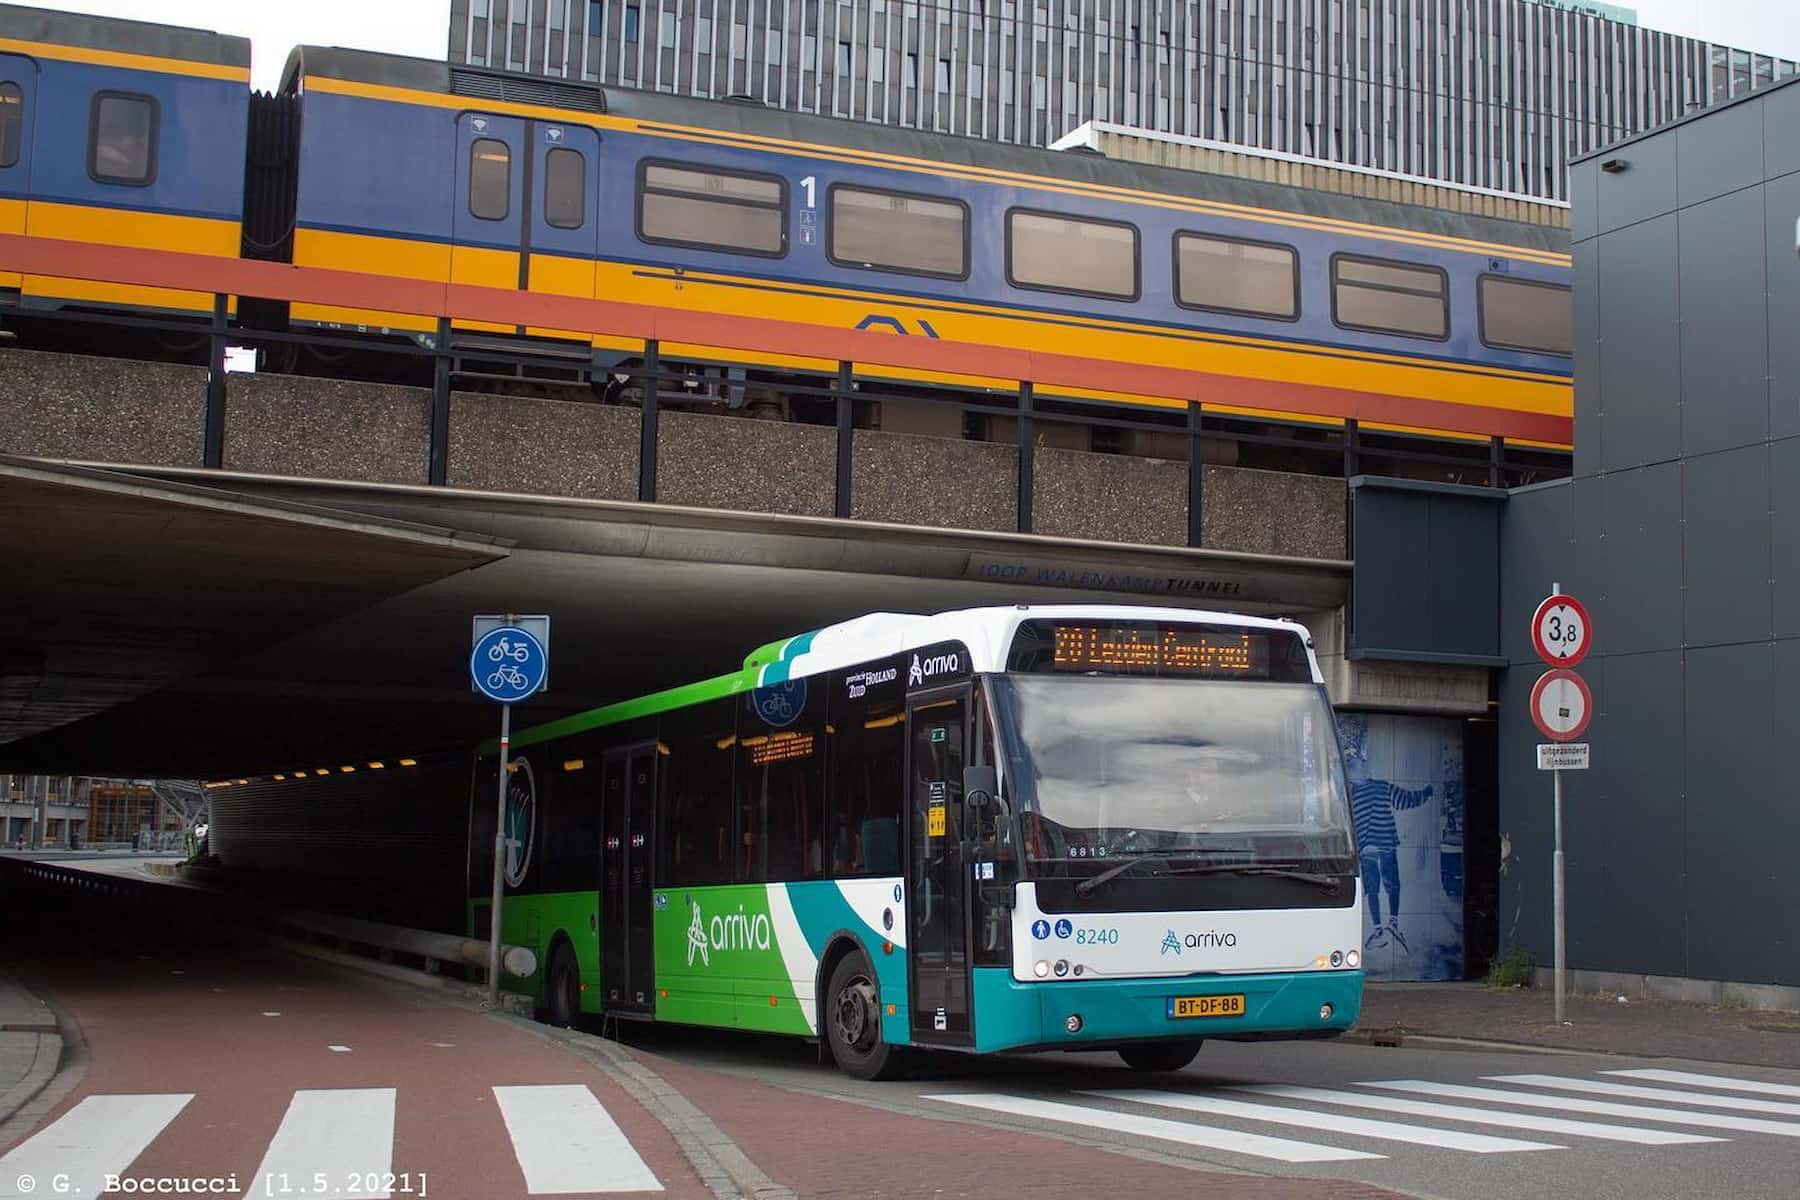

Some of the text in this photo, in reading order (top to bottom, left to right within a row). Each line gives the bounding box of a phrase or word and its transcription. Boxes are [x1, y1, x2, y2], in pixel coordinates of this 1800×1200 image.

[800, 176, 816, 208] 1
[1548, 616, 1577, 646] 3,8
[1054, 627, 1250, 669] 20 Leiden Centraal
[922, 653, 959, 676] arriva
[1070, 846, 1106, 857] 6813
[710, 903, 770, 951] arriva
[1075, 928, 1119, 945] 8240
[1184, 929, 1237, 948] arriva
[1178, 997, 1239, 1014] BT-DF-88
